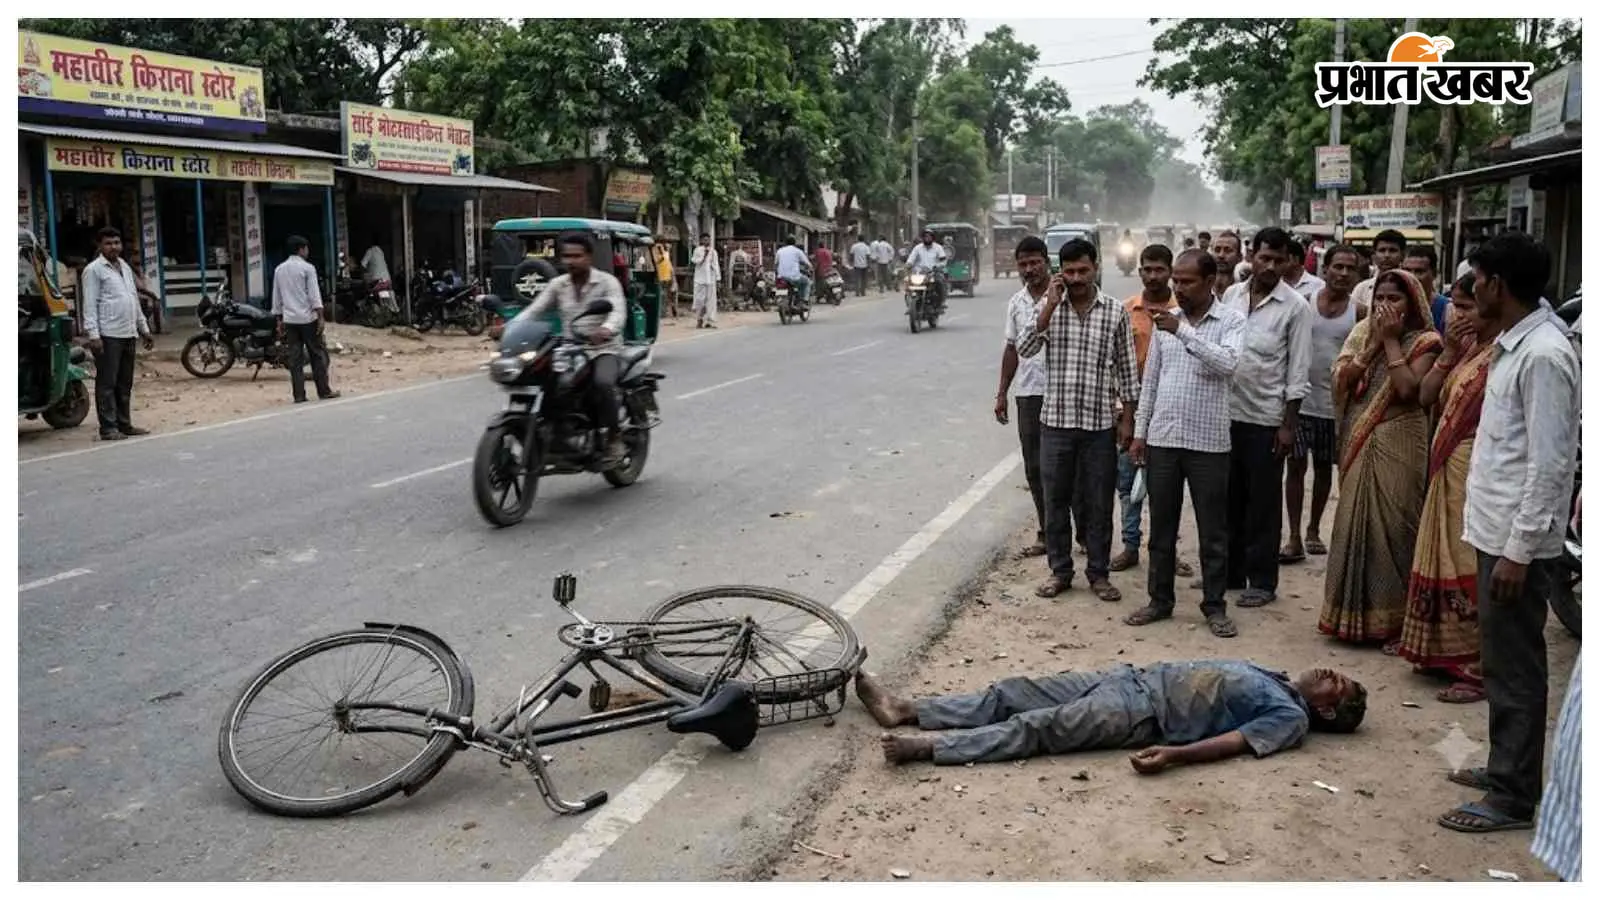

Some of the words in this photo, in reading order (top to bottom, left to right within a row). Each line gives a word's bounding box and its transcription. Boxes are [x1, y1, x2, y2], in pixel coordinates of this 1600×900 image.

[50, 49, 124, 87] महावीर
[130, 53, 195, 96] किराना
[199, 65, 236, 100] स्टोर
[54, 144, 116, 168] महावीर
[121, 147, 175, 172] किराना
[180, 152, 211, 174] स्टोर
